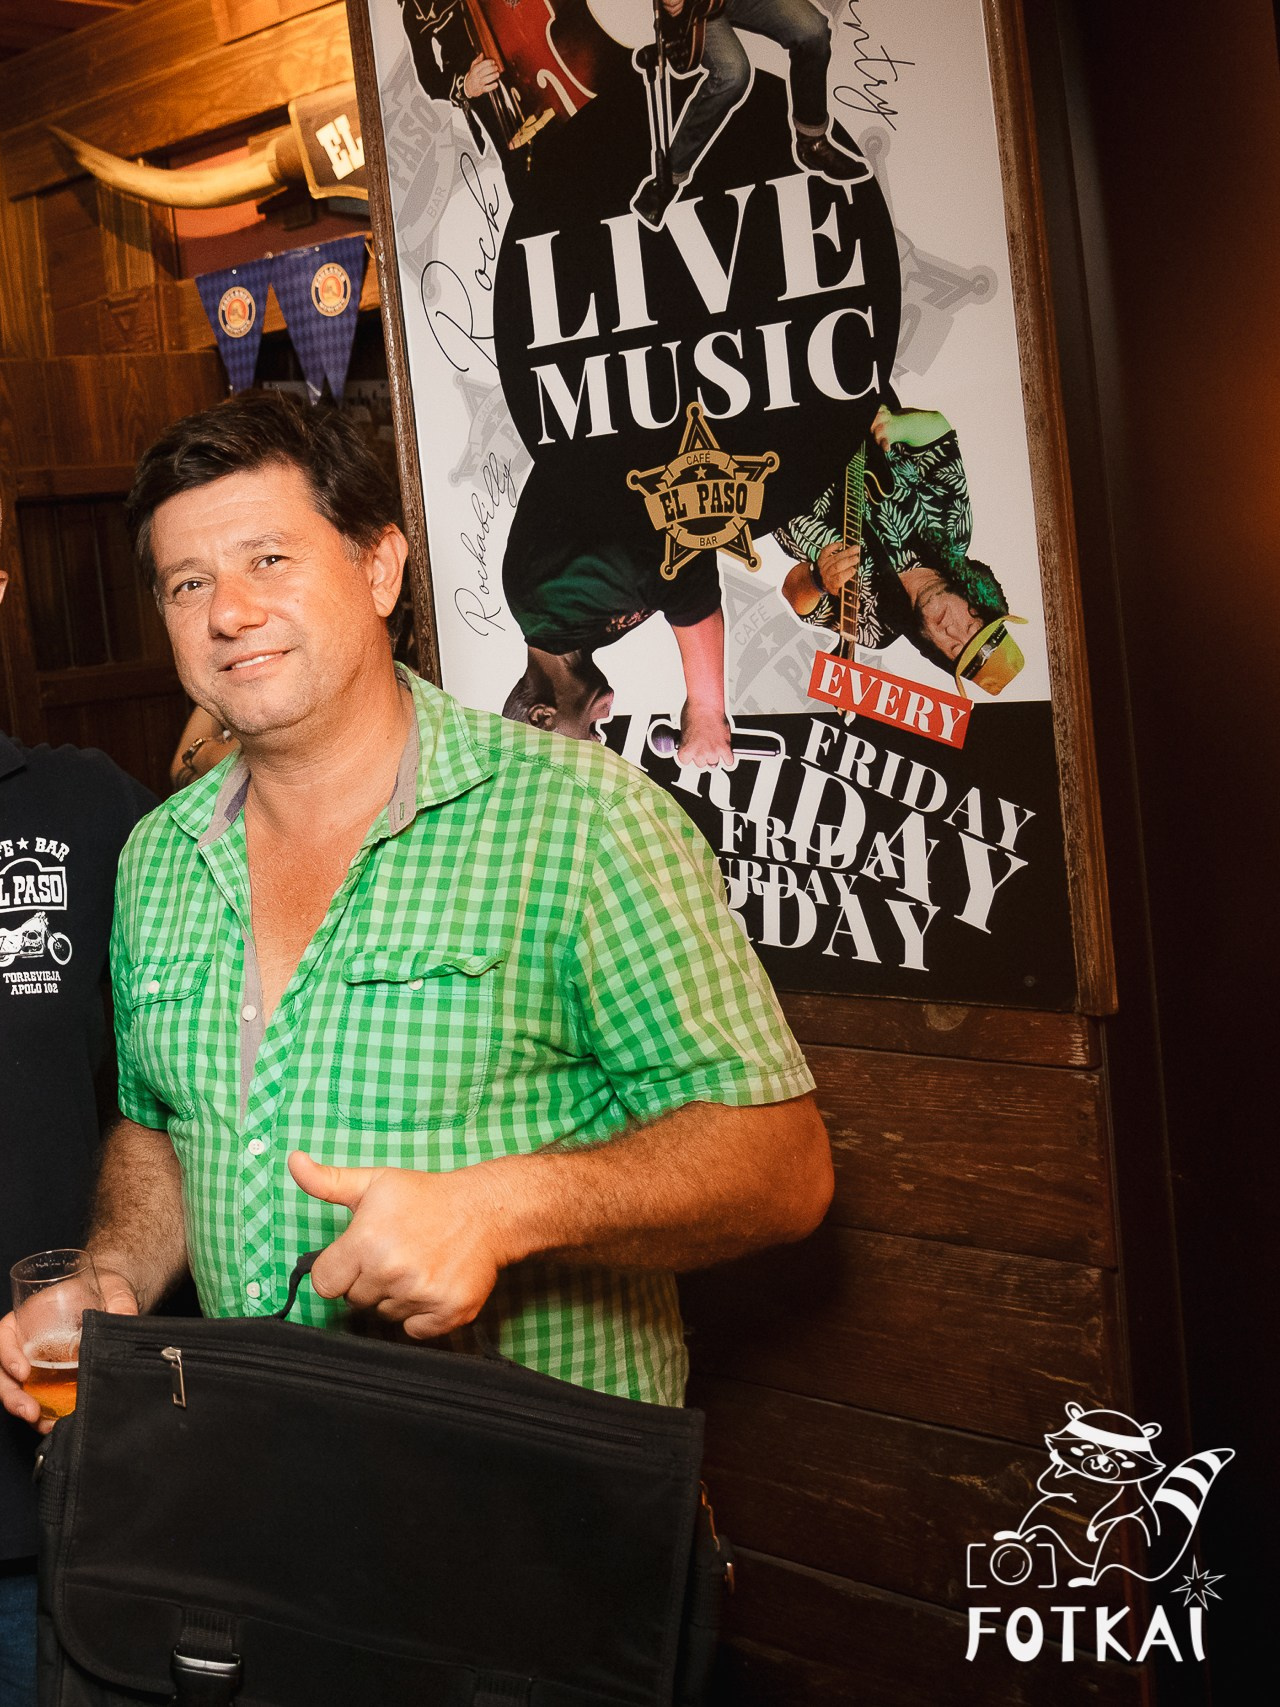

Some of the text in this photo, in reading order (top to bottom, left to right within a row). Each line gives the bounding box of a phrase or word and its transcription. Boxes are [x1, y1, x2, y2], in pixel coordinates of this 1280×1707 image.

[315, 113, 366, 180] EL
[420, 152, 500, 373] Rock
[515, 172, 866, 349] LIVE
[530, 305, 880, 445] MUSIC
[686, 451, 711, 466] CAFÉ
[658, 482, 748, 523] EL PASO
[454, 452, 517, 636] Rockabilly
[699, 535, 718, 547] BAR
[816, 658, 967, 743] EVERY
[799, 717, 1037, 853] FRIDAY
[35, 836, 70, 862] BAR
[13, 874, 63, 905] PASO
[3, 970, 62, 983] TORREVIEJA
[10, 982, 59, 995] APOLO 102
